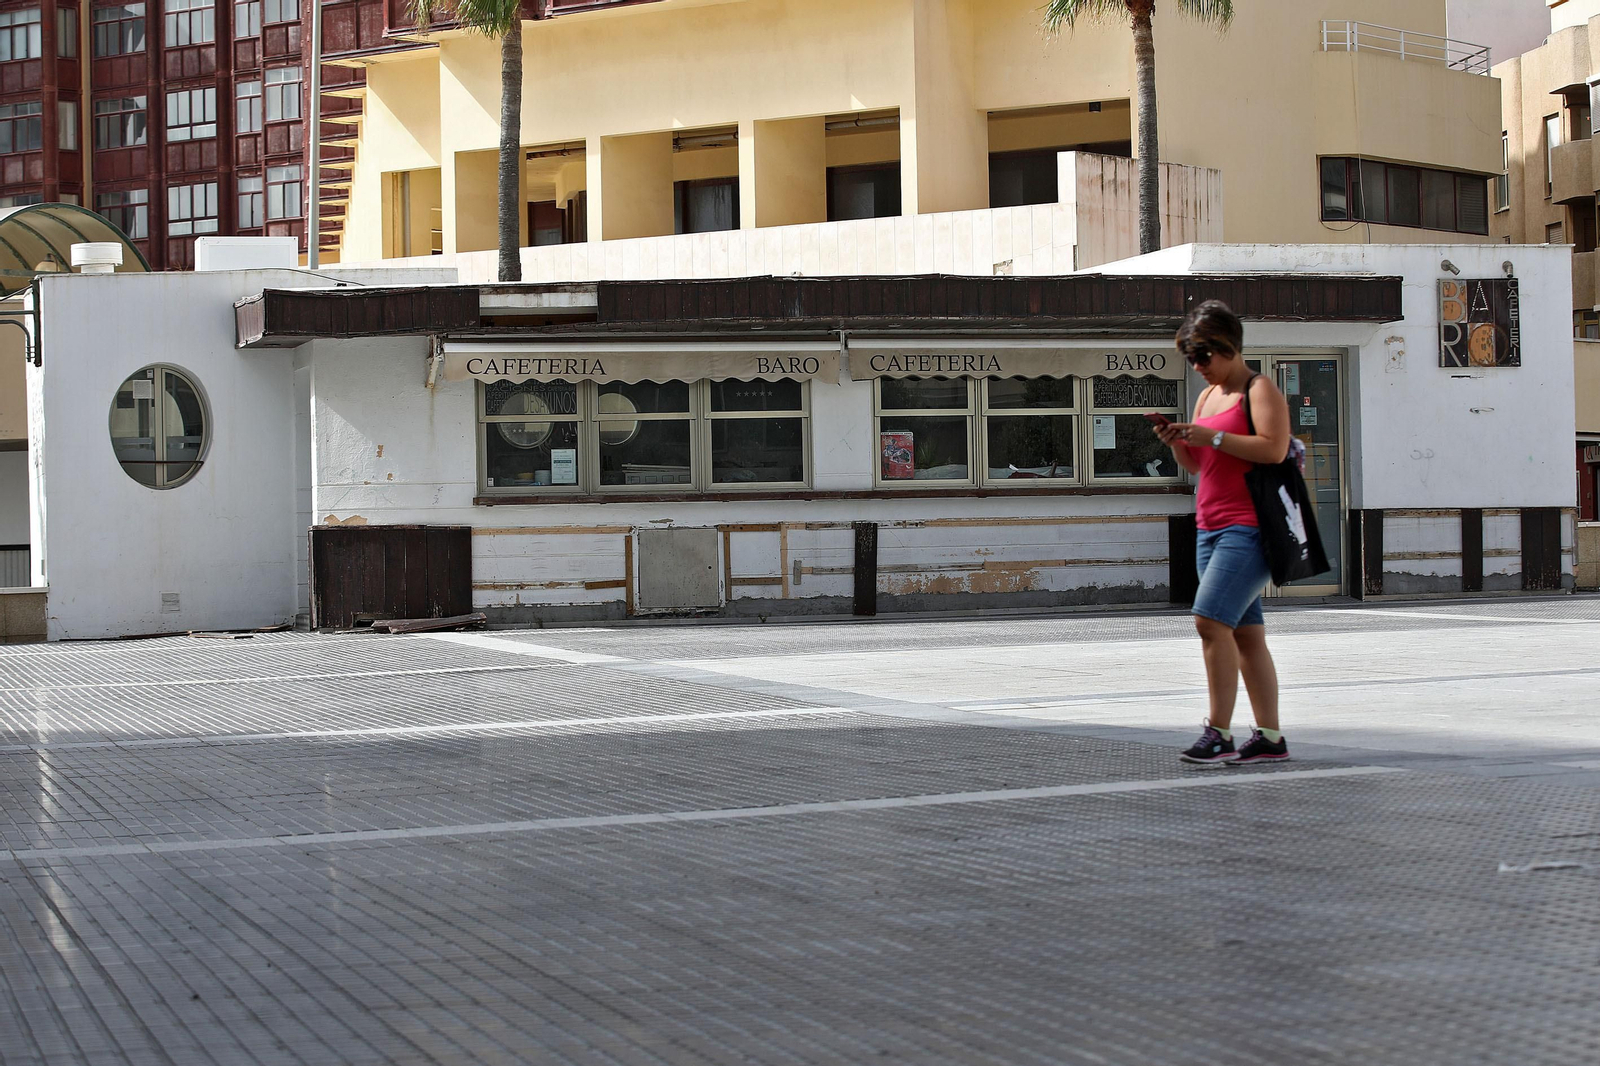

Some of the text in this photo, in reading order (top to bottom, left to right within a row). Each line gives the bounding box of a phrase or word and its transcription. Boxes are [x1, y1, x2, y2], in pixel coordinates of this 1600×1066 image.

[466, 357, 820, 376] CAFETERIA BARO
[869, 354, 1166, 373] CAFETERIA BARO
[523, 391, 577, 413] DESAYUNOS
[1127, 385, 1177, 406] DESAYUNOS
